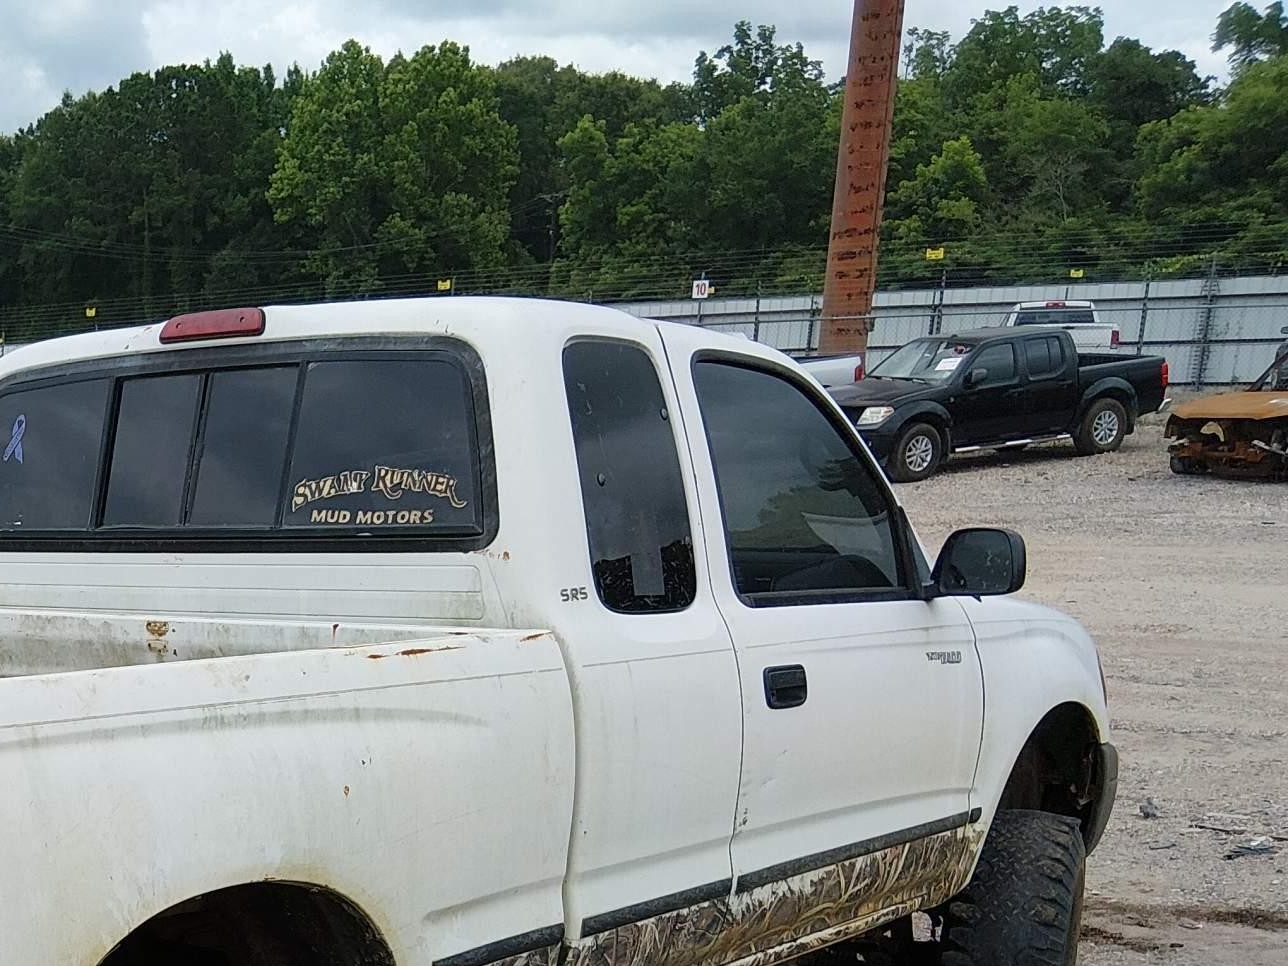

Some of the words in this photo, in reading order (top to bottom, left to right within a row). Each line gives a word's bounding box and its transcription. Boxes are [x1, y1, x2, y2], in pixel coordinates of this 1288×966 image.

[695, 282, 707, 296] 10
[371, 465, 467, 509] RUNNER
[311, 509, 351, 524] MUD
[355, 508, 434, 525] MOTORS
[560, 586, 589, 602] SR5
